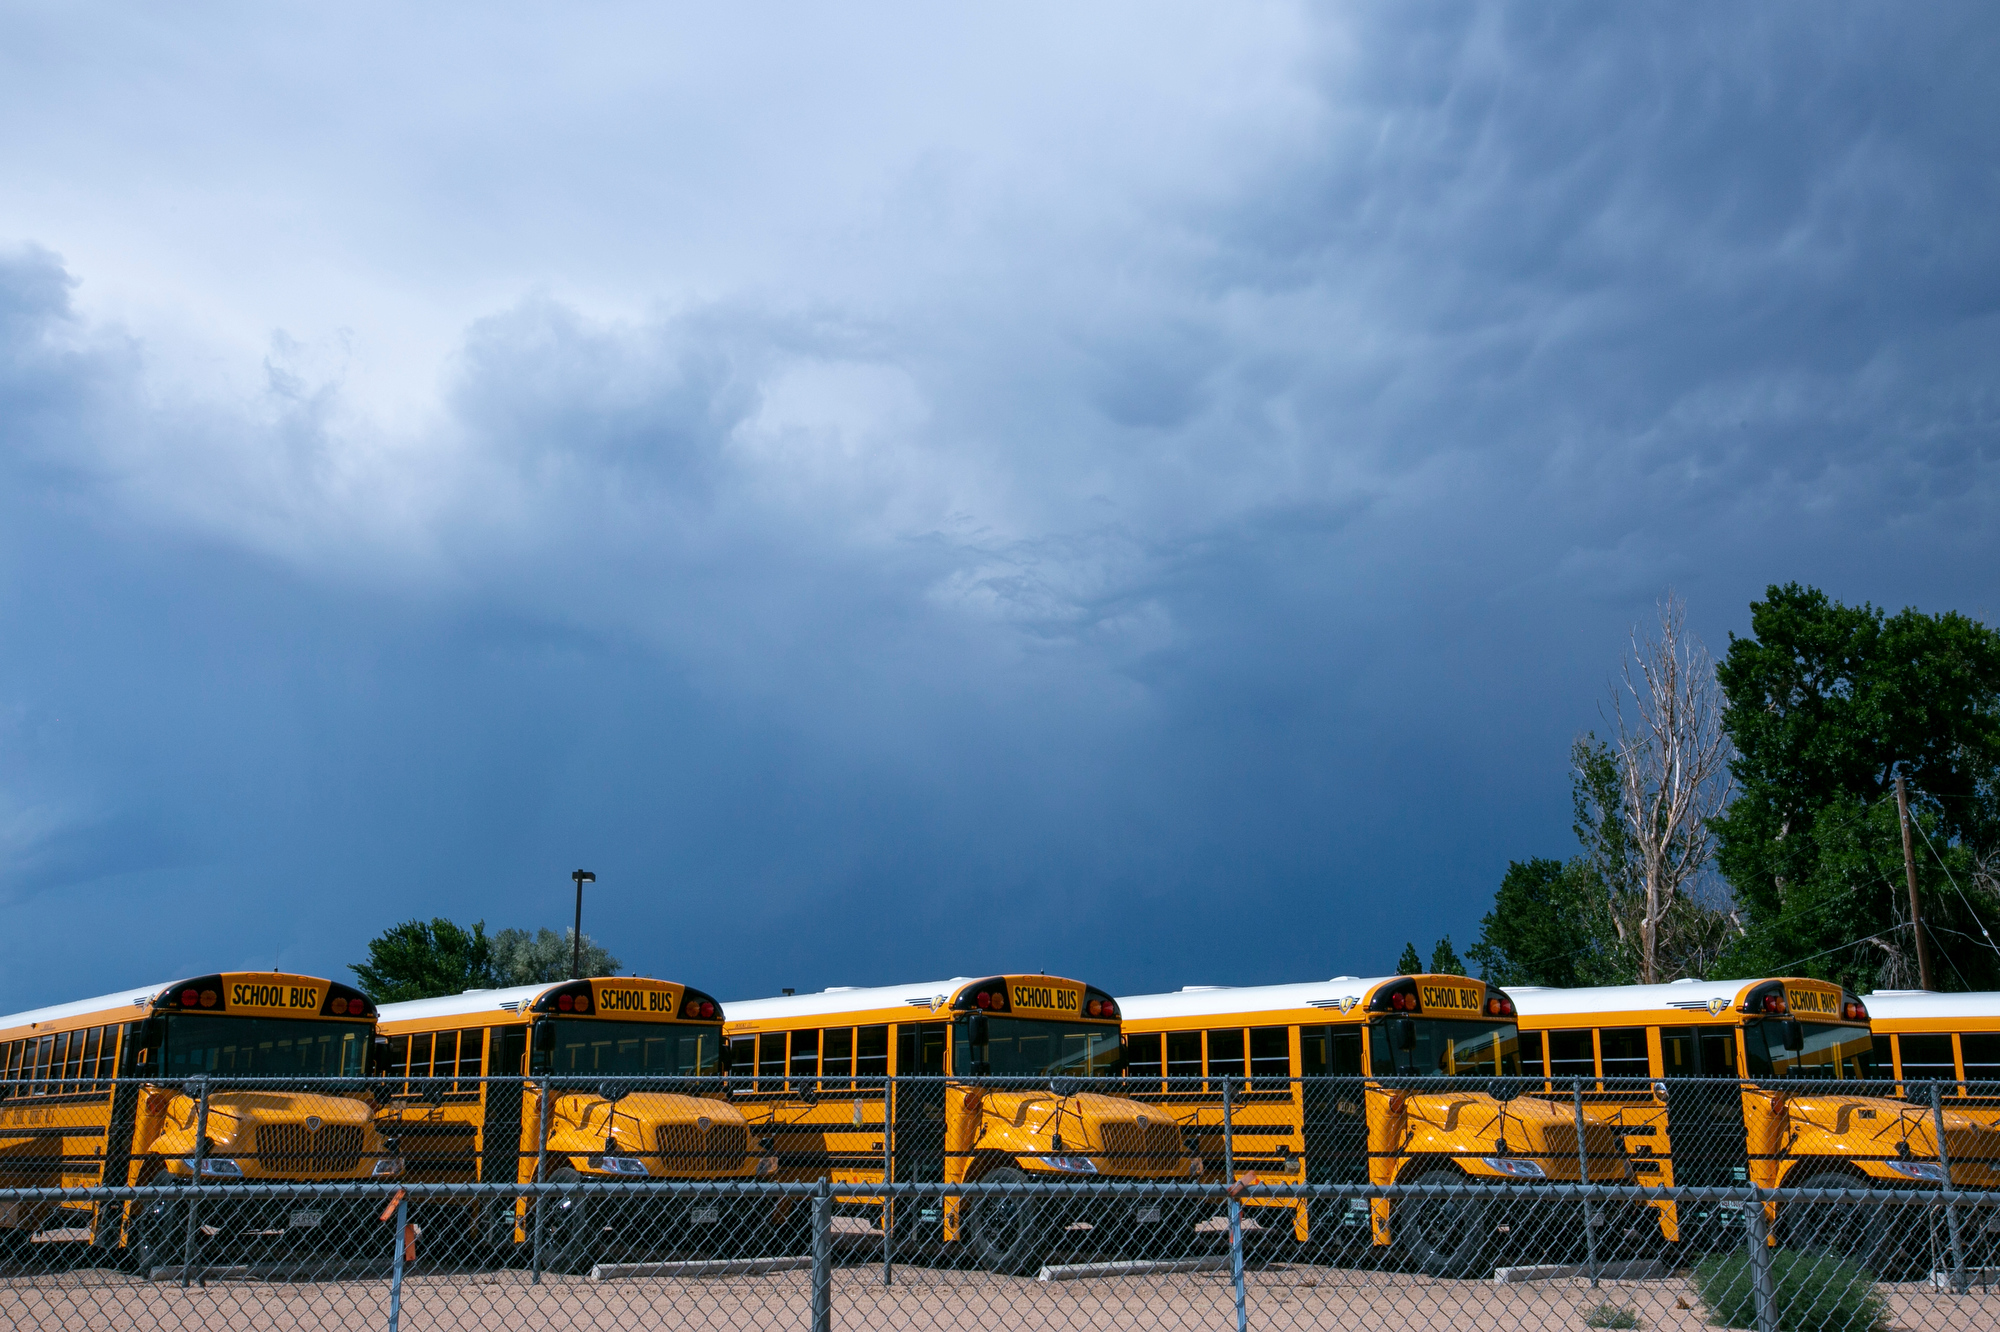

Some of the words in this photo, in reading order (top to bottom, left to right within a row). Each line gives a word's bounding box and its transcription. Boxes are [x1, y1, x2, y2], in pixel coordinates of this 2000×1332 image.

[232, 984, 286, 1007] SCHOOL
[289, 987, 317, 1009] BUS
[600, 989, 647, 1010] SCHOOL
[649, 992, 672, 1012] BUS
[1014, 986, 1055, 1009] SCHOOL
[1056, 989, 1077, 1010] BUS
[1423, 986, 1459, 1008] SCHOOL
[1460, 989, 1479, 1010] BUS
[1789, 990, 1821, 1012] SCHOOL
[1820, 992, 1837, 1014] BUS
